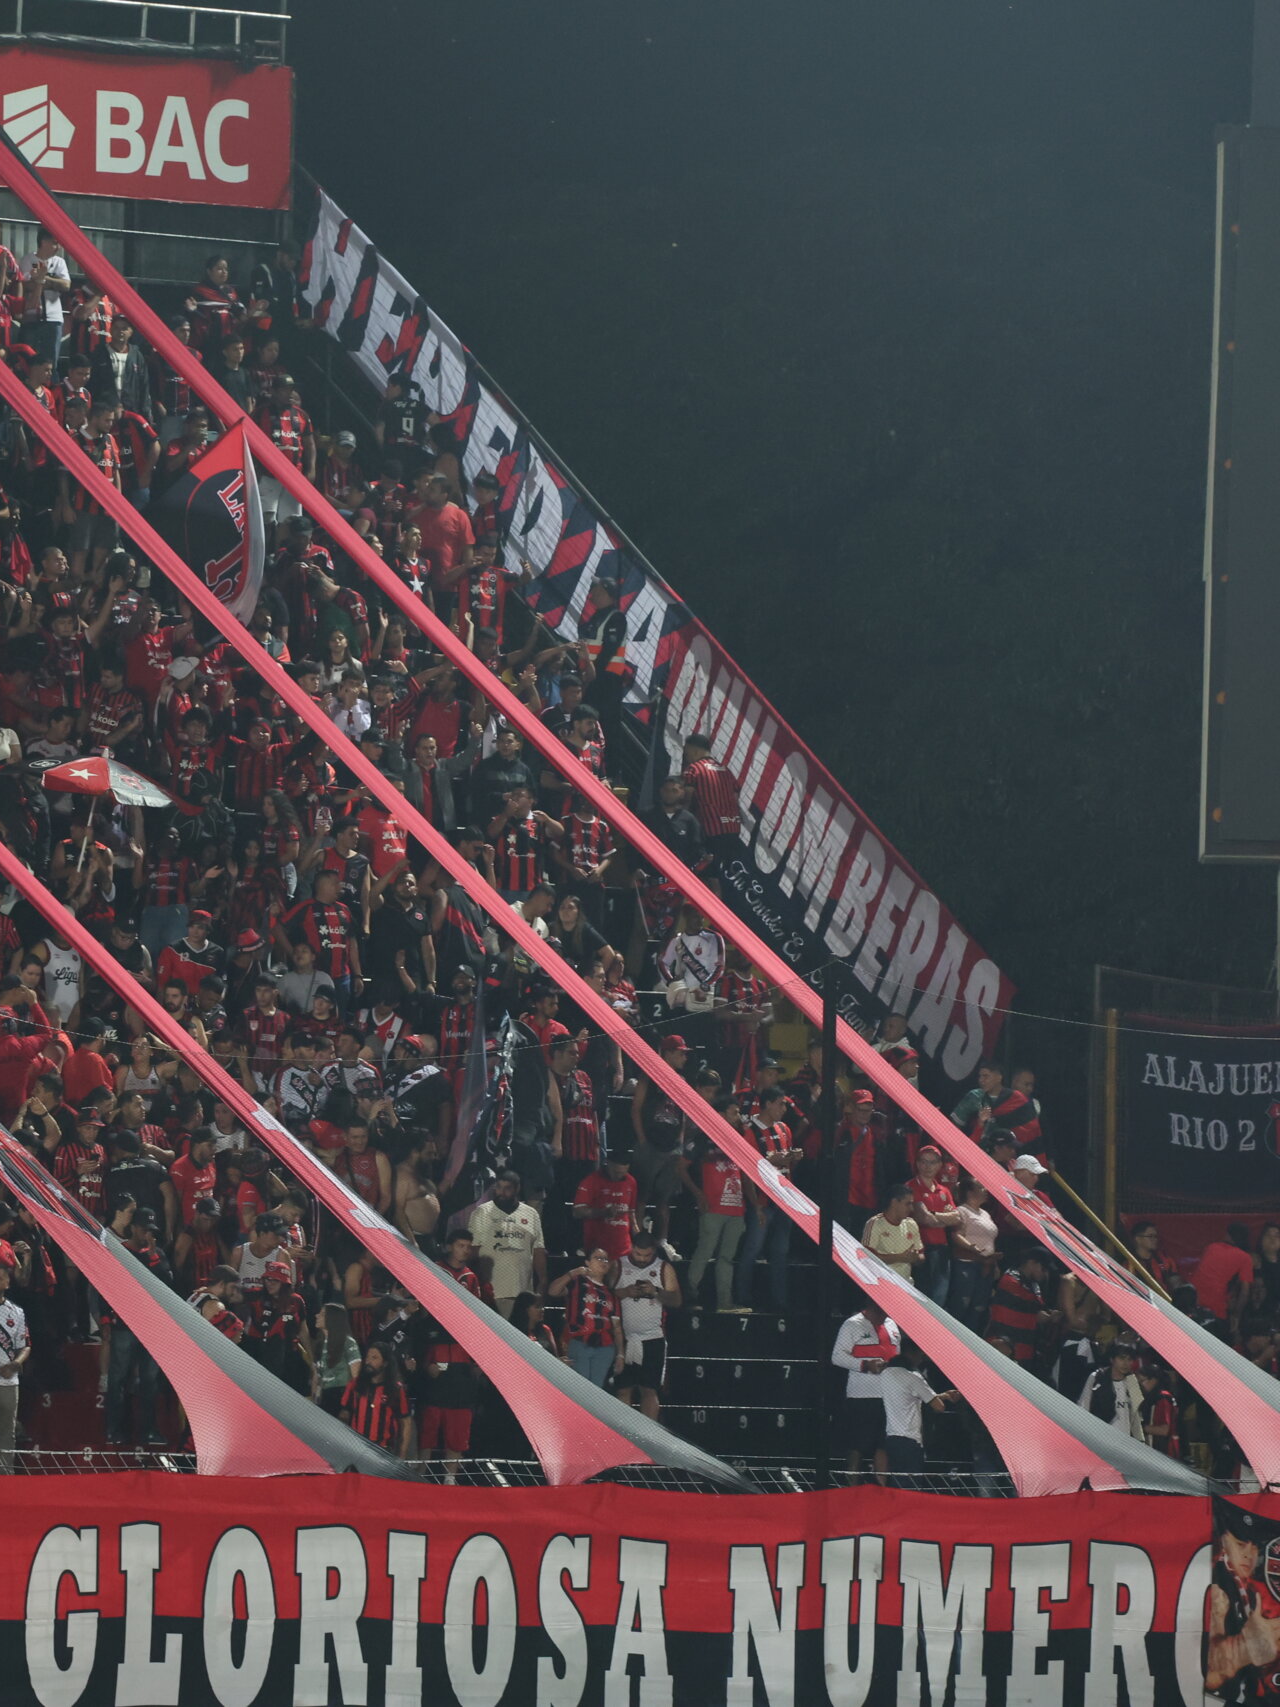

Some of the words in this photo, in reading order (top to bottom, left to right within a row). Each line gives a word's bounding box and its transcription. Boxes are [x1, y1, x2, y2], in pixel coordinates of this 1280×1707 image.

[96, 90, 249, 183] BAC
[652, 1003, 661, 1016] 2
[1169, 1113, 1230, 1152] RIO
[1238, 1120, 1256, 1151] 2
[739, 1317, 746, 1331] 7
[695, 1364, 703, 1378] 9
[782, 1365, 790, 1379] 7
[42, 1394, 51, 1408] 3
[95, 1394, 105, 1408] 2
[692, 1409, 706, 1424] 10
[739, 1414, 747, 1429] 9
[24, 1522, 674, 1707] GLORIOSA
